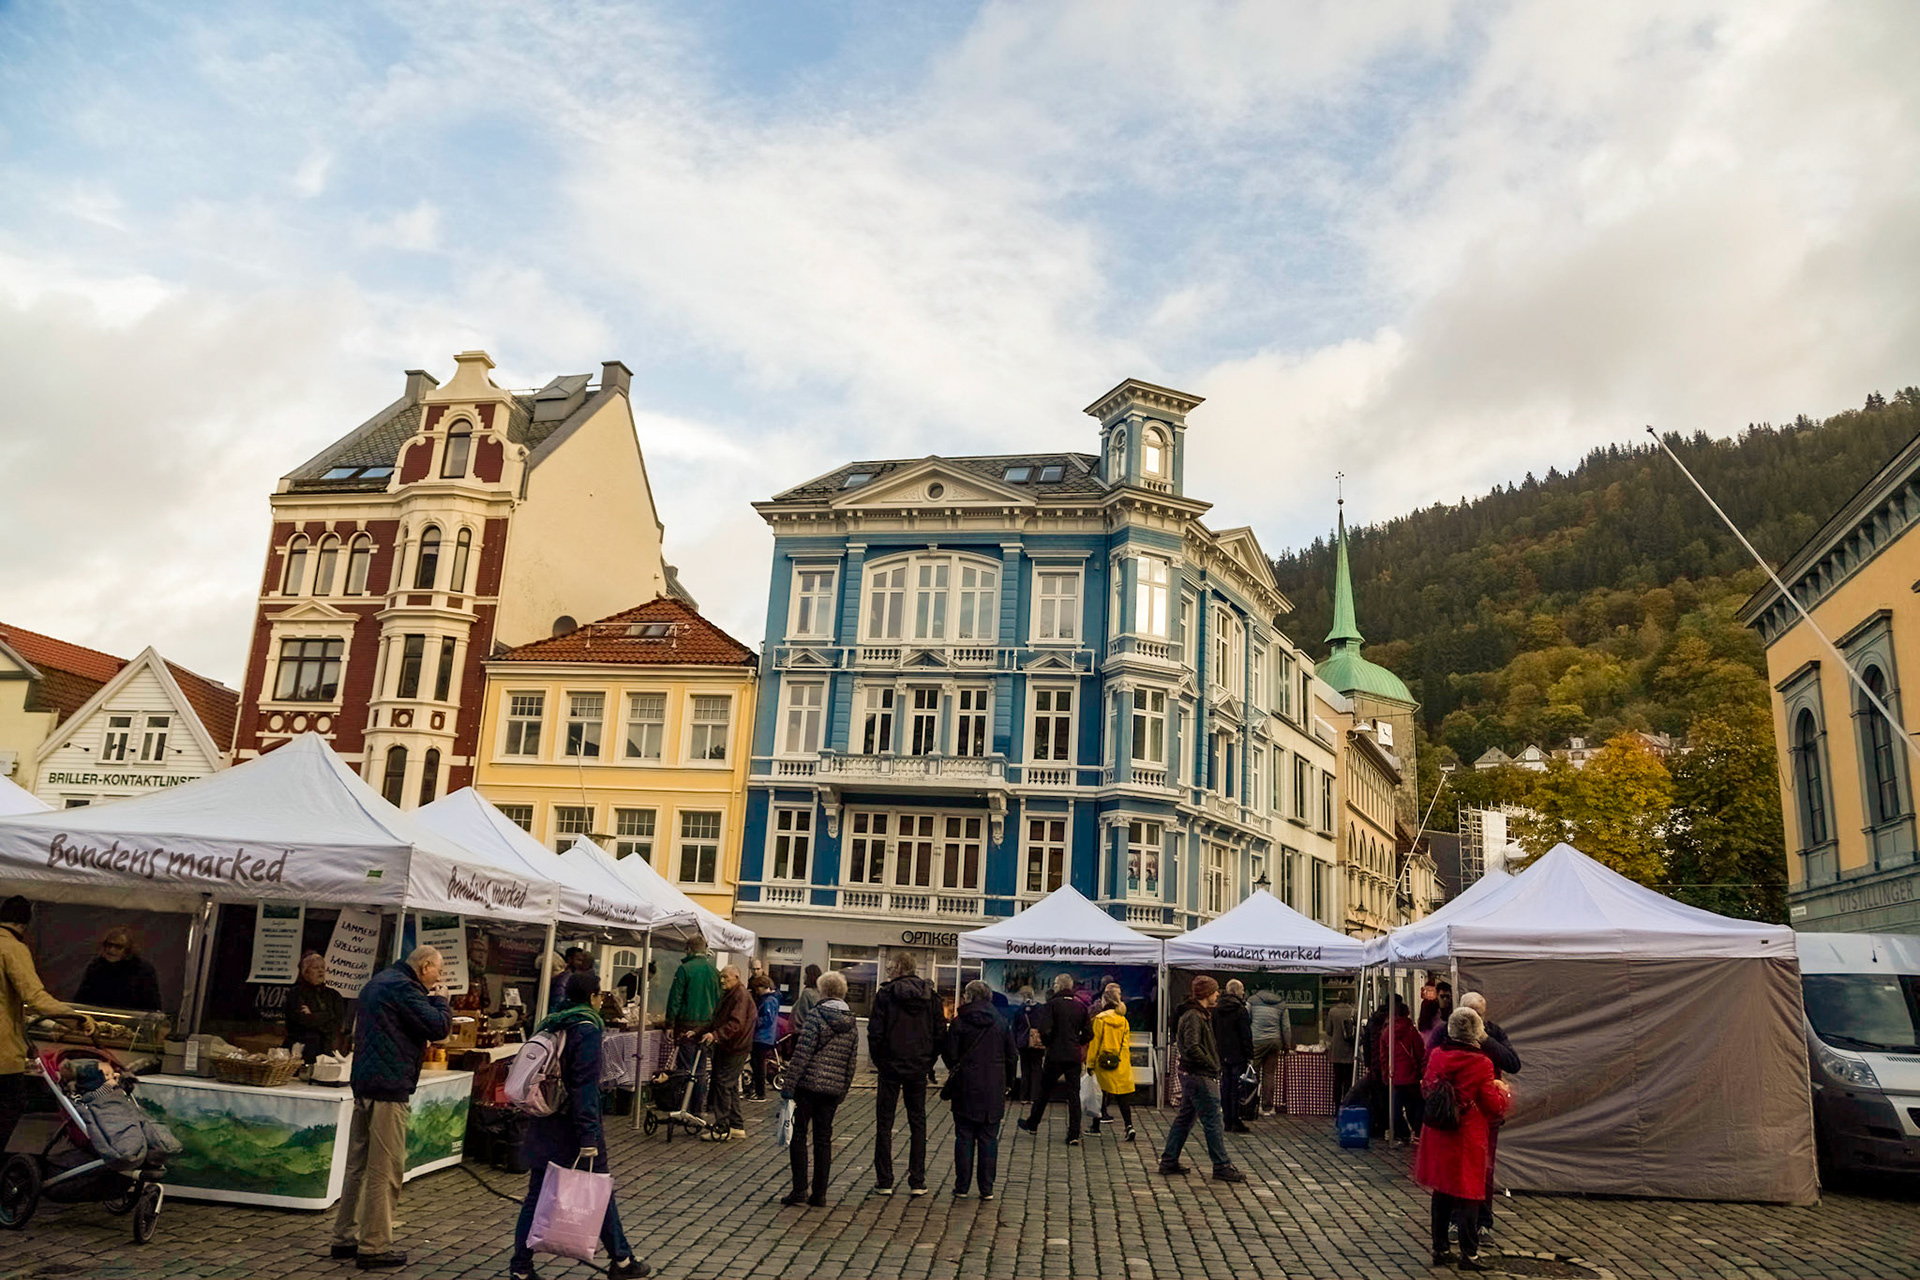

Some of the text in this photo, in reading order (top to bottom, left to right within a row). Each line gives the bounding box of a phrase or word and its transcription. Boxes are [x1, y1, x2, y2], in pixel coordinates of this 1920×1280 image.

[48, 772, 203, 788] BRILLER-KONTAKTLINS
[46, 832, 288, 884] Bondens marked
[492, 879, 530, 909] marked
[1837, 878, 1915, 913] UTSTILLINGER
[901, 929, 958, 947] OPTIKER
[1006, 939, 1112, 958] Bondens marked
[1213, 944, 1322, 962] Bondens marked
